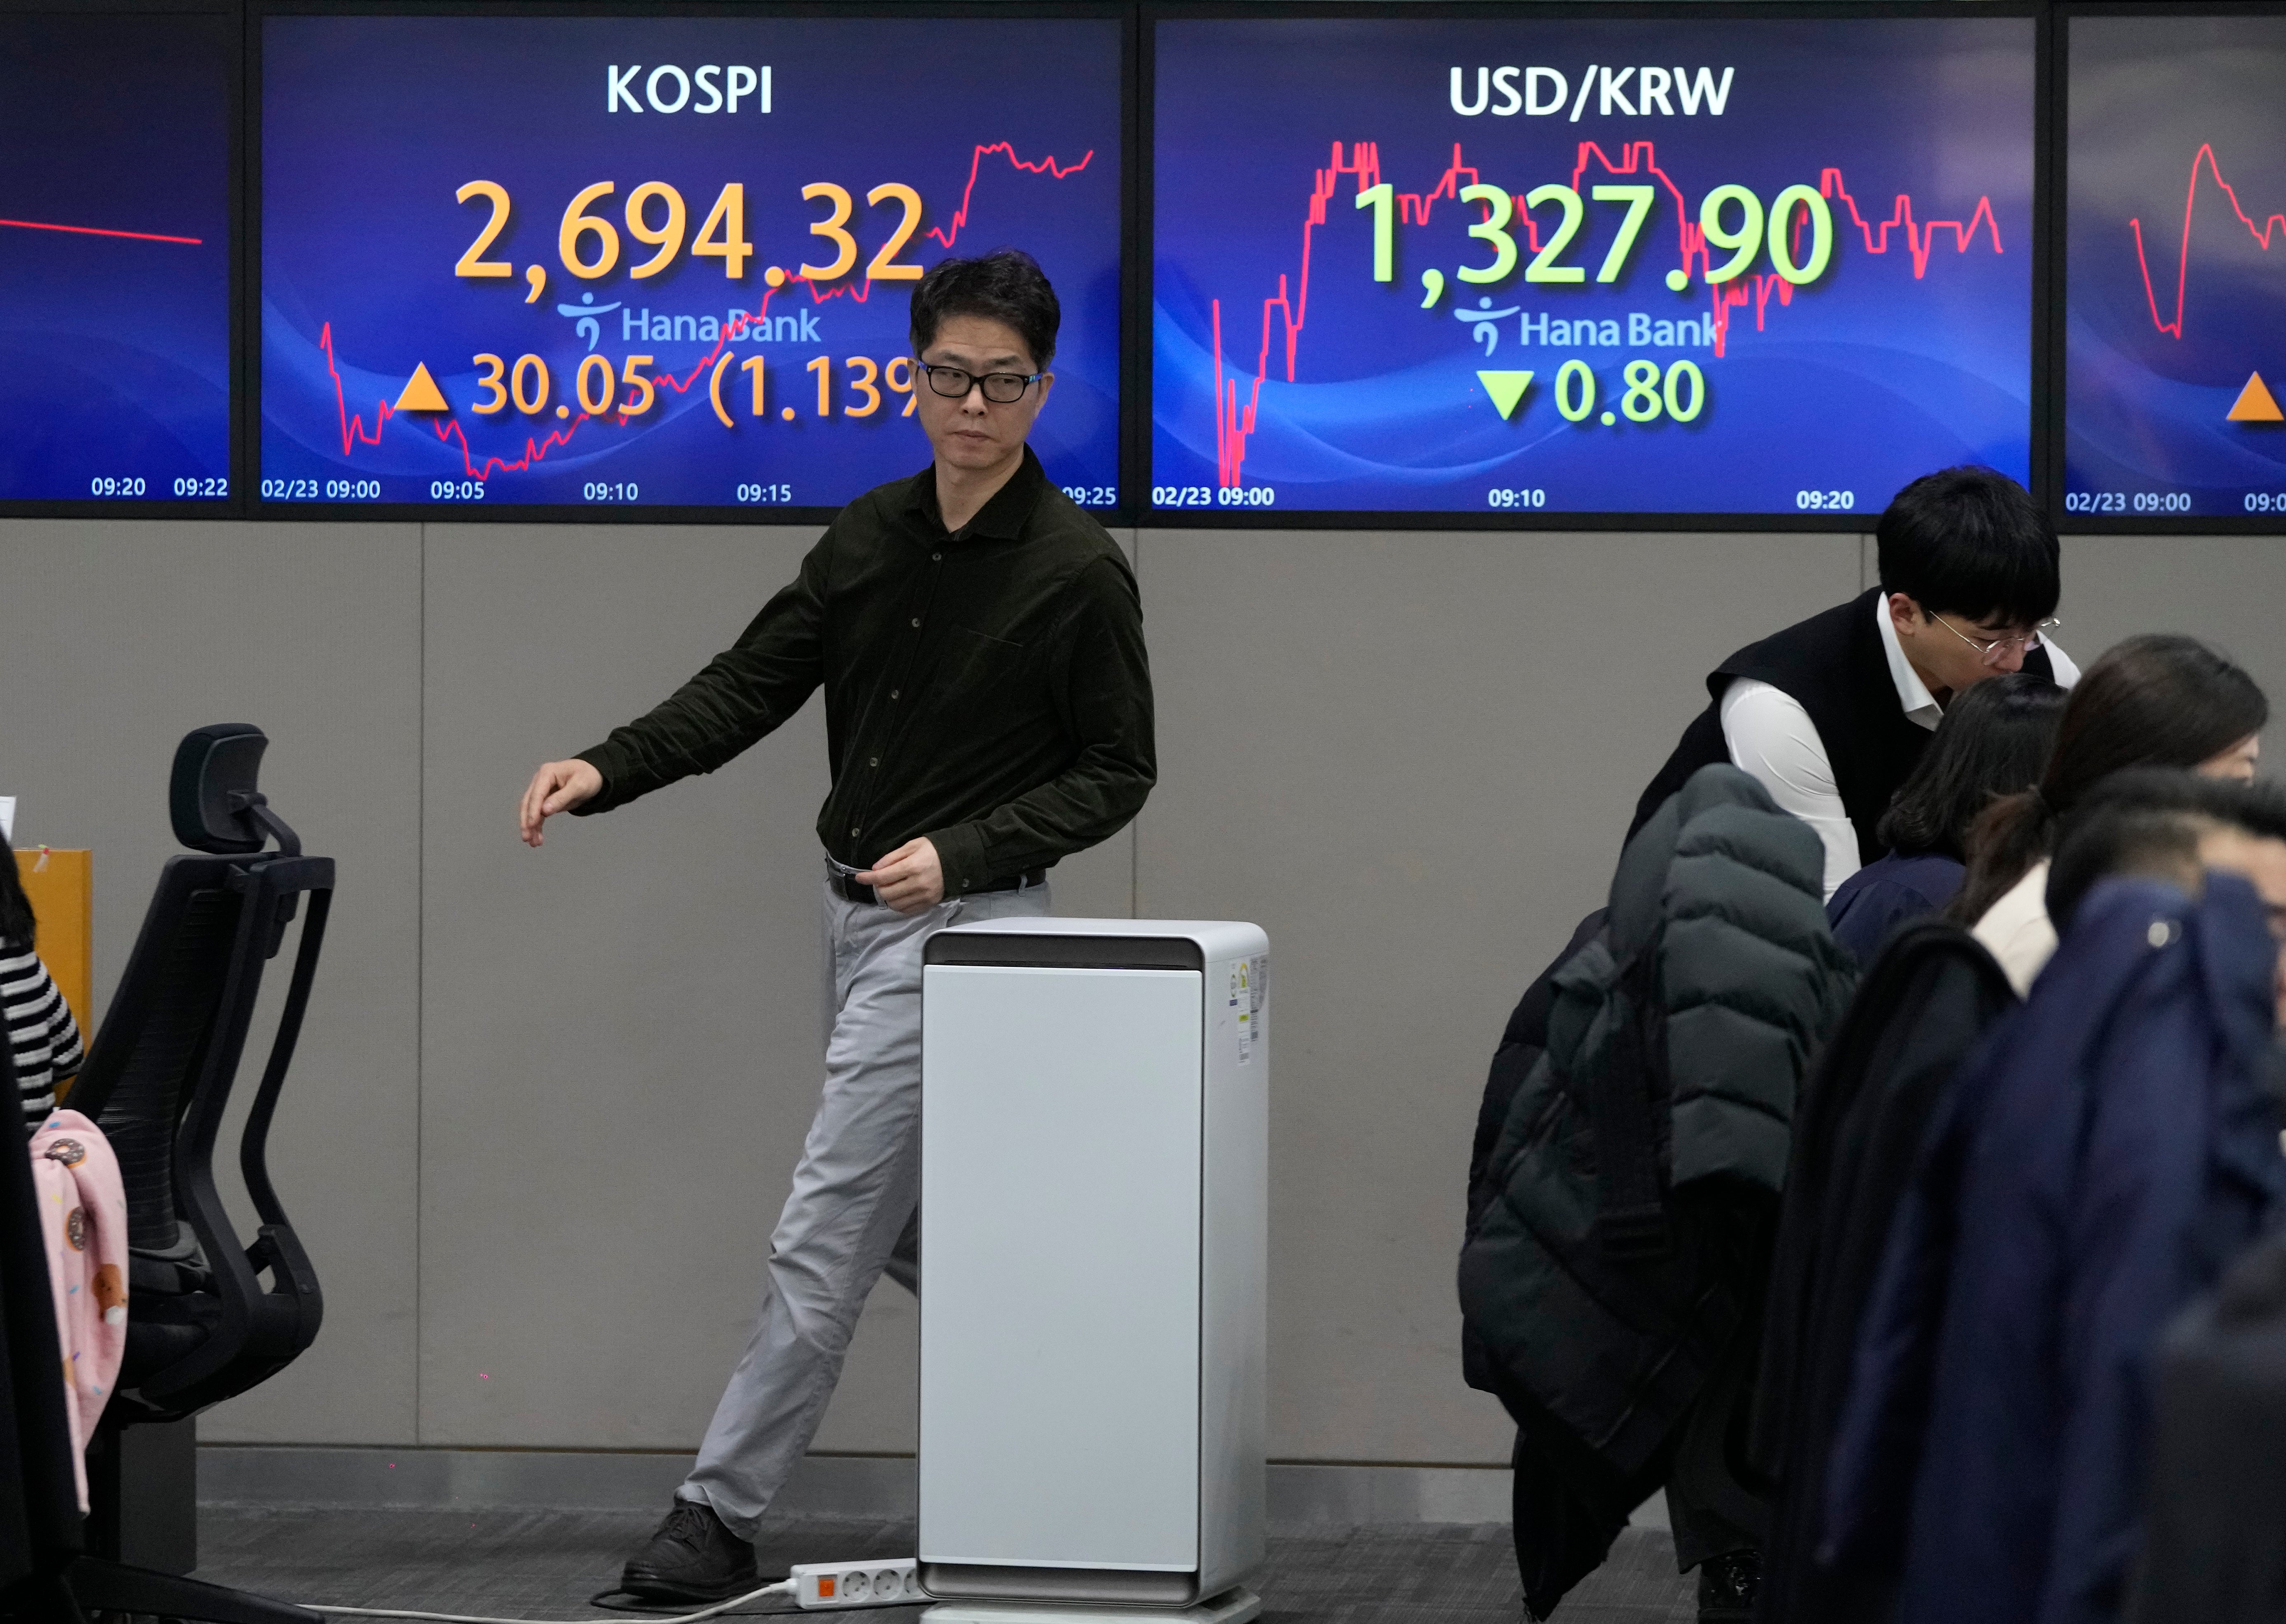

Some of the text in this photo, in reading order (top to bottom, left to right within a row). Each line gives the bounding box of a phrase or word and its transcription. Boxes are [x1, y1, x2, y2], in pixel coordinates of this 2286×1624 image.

[608, 64, 771, 114] KOSPI
[1450, 64, 1735, 123] USD/KRW
[456, 180, 924, 303] 2,694.32
[1356, 183, 1832, 308] 1,327.90
[623, 308, 821, 342] Hana Bank
[1520, 311, 1722, 347] Hana Bank
[472, 354, 654, 418] 30.05
[1555, 359, 1704, 426] 0.80
[92, 477, 227, 496] 09:20 09:22
[262, 479, 318, 500] 02/23
[327, 480, 380, 498] 09:00
[431, 481, 484, 499] 09:05
[584, 482, 638, 500] 09:10
[737, 484, 791, 502] 09:15
[1152, 487, 1855, 510] 02/23 09:00 09:10 09:20
[2066, 493, 2126, 512] 02/23
[2133, 493, 2191, 511] 09:00
